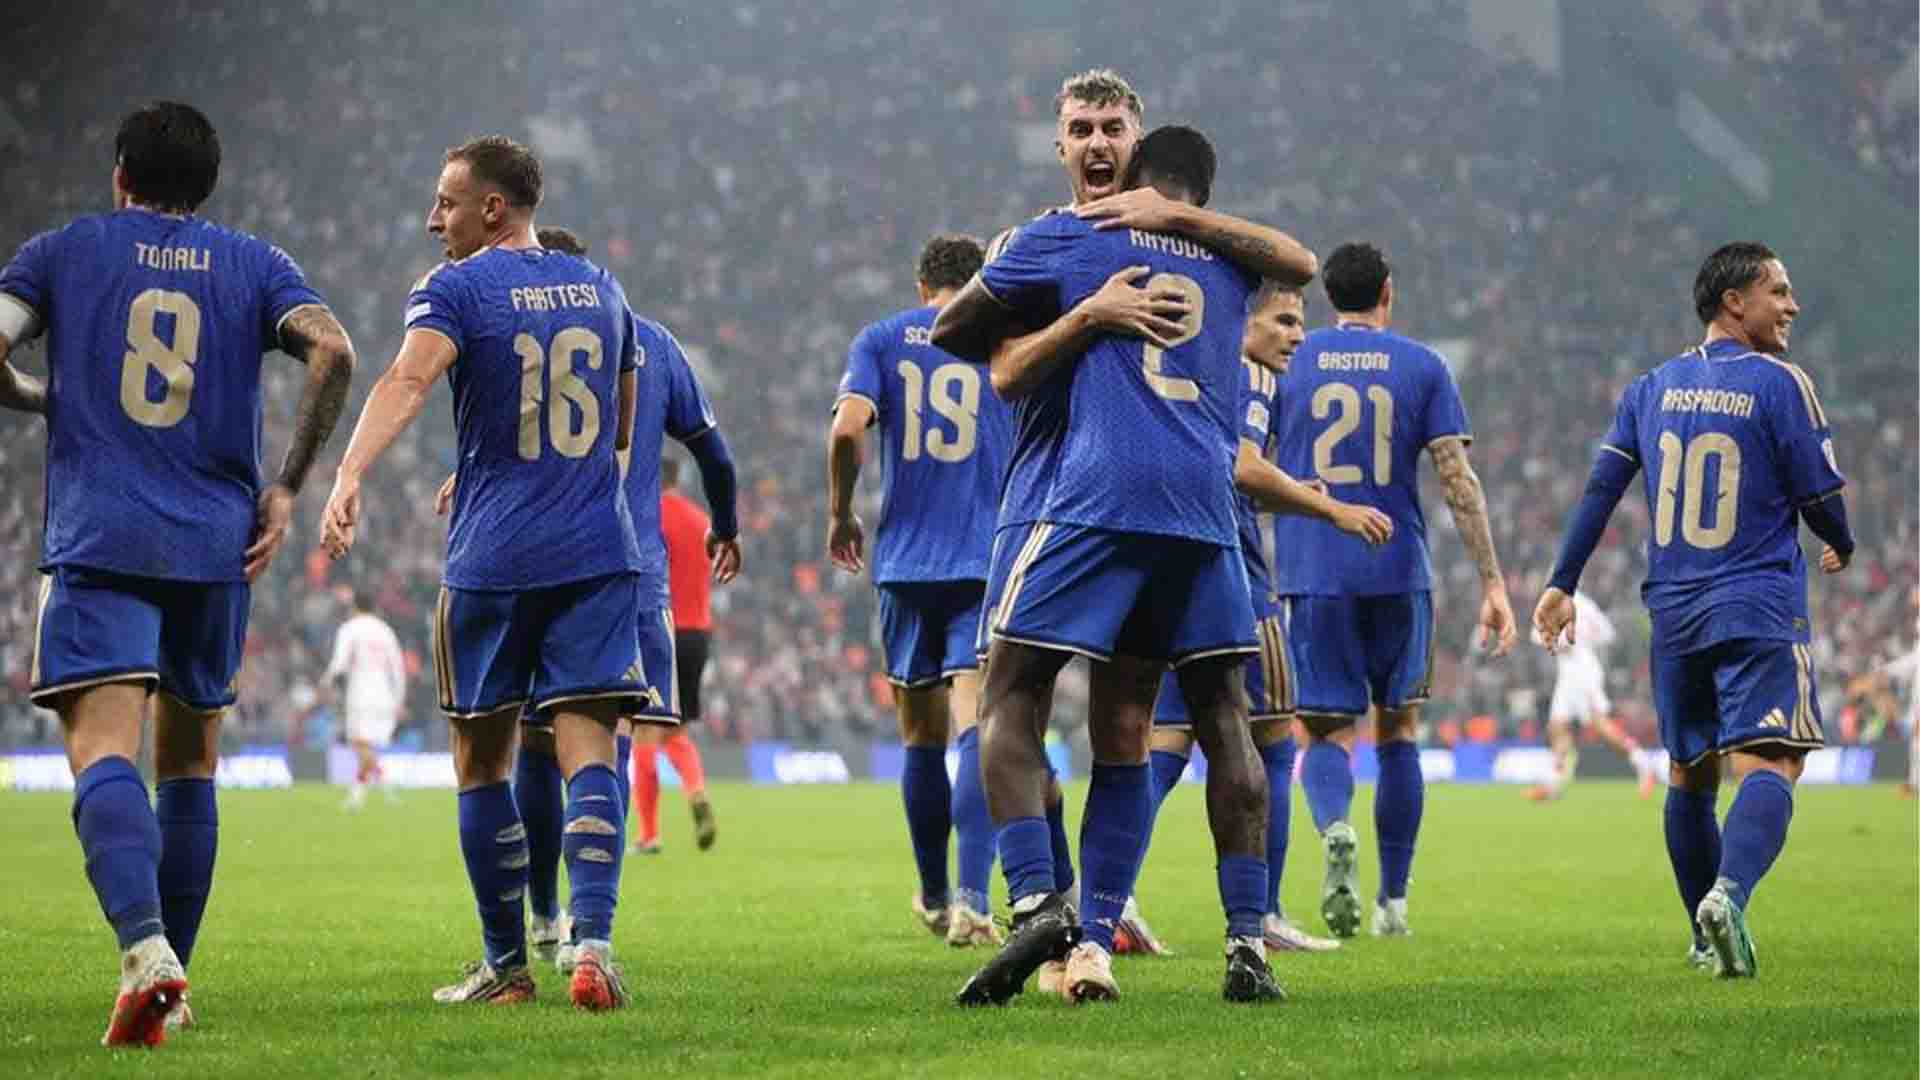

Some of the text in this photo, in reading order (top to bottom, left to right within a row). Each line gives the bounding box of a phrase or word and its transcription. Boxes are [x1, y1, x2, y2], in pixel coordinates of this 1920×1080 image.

[135, 242, 210, 272] TONALI
[511, 284, 600, 312] FRATTESI
[120, 288, 200, 428] 8
[1143, 273, 1204, 400] 2
[1317, 352, 1390, 371] BASTONI
[513, 327, 603, 459] 16
[898, 359, 980, 463] 19
[1312, 382, 1393, 485] 21
[1662, 388, 1755, 419] RASPADORI
[1655, 431, 1741, 549] 10
